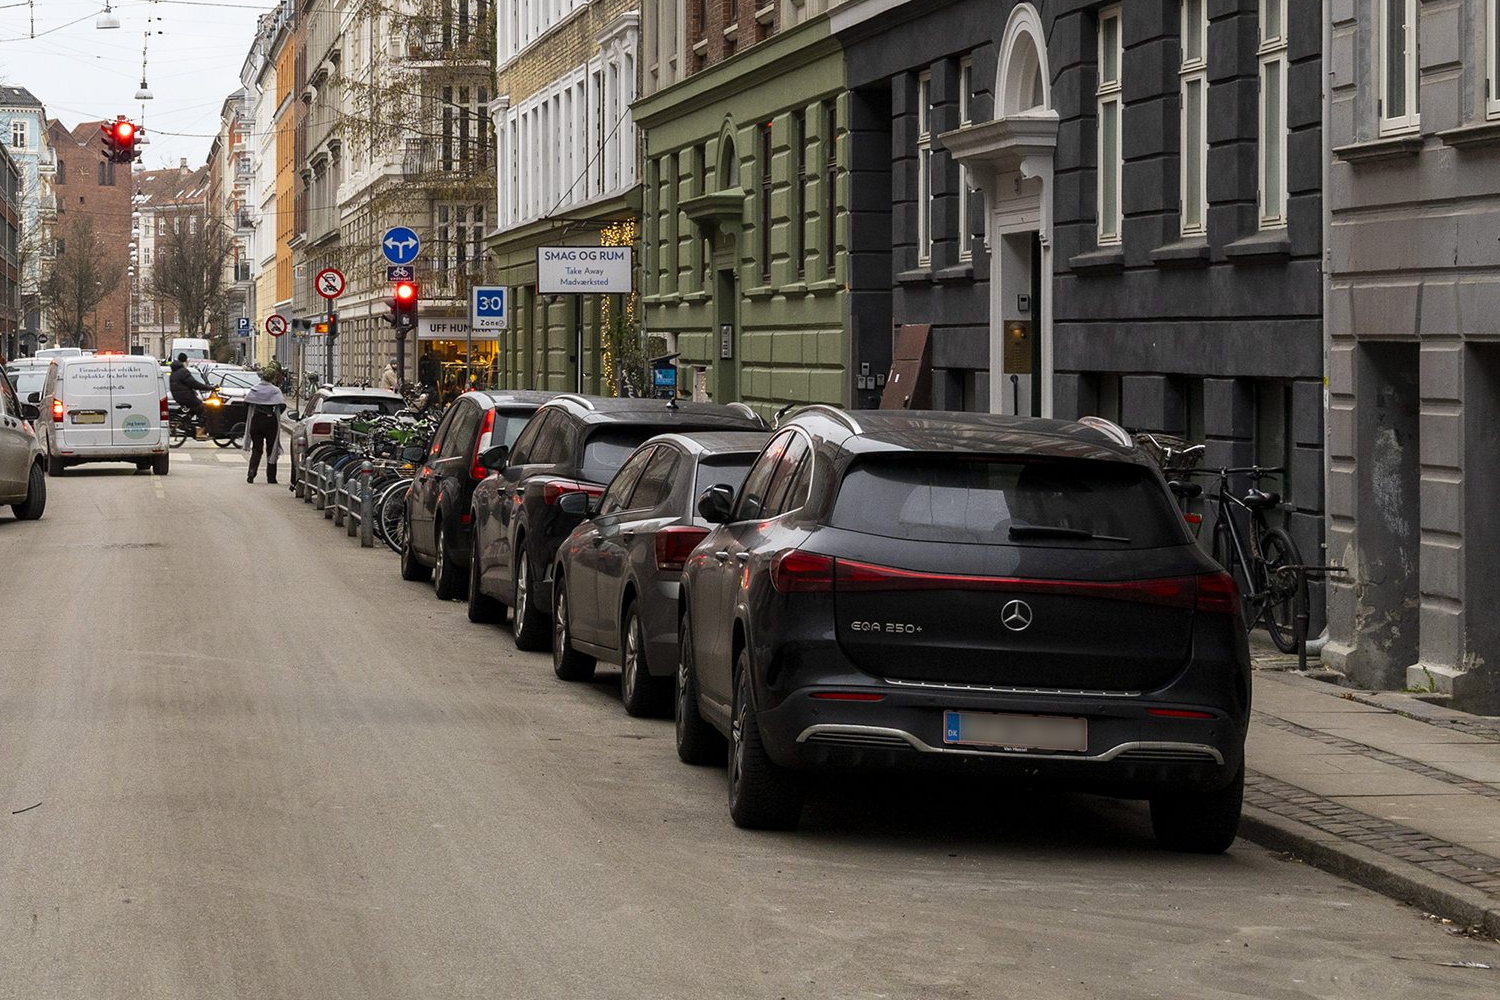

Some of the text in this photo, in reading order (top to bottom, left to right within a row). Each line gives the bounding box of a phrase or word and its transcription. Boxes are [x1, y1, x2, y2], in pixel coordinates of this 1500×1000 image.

[544, 251, 624, 260] SMAG OG RUM
[584, 268, 604, 276] Away
[480, 296, 502, 310] 30
[240, 319, 246, 328] P
[430, 324, 447, 332] UFF
[851, 621, 923, 634] EQA 250+
